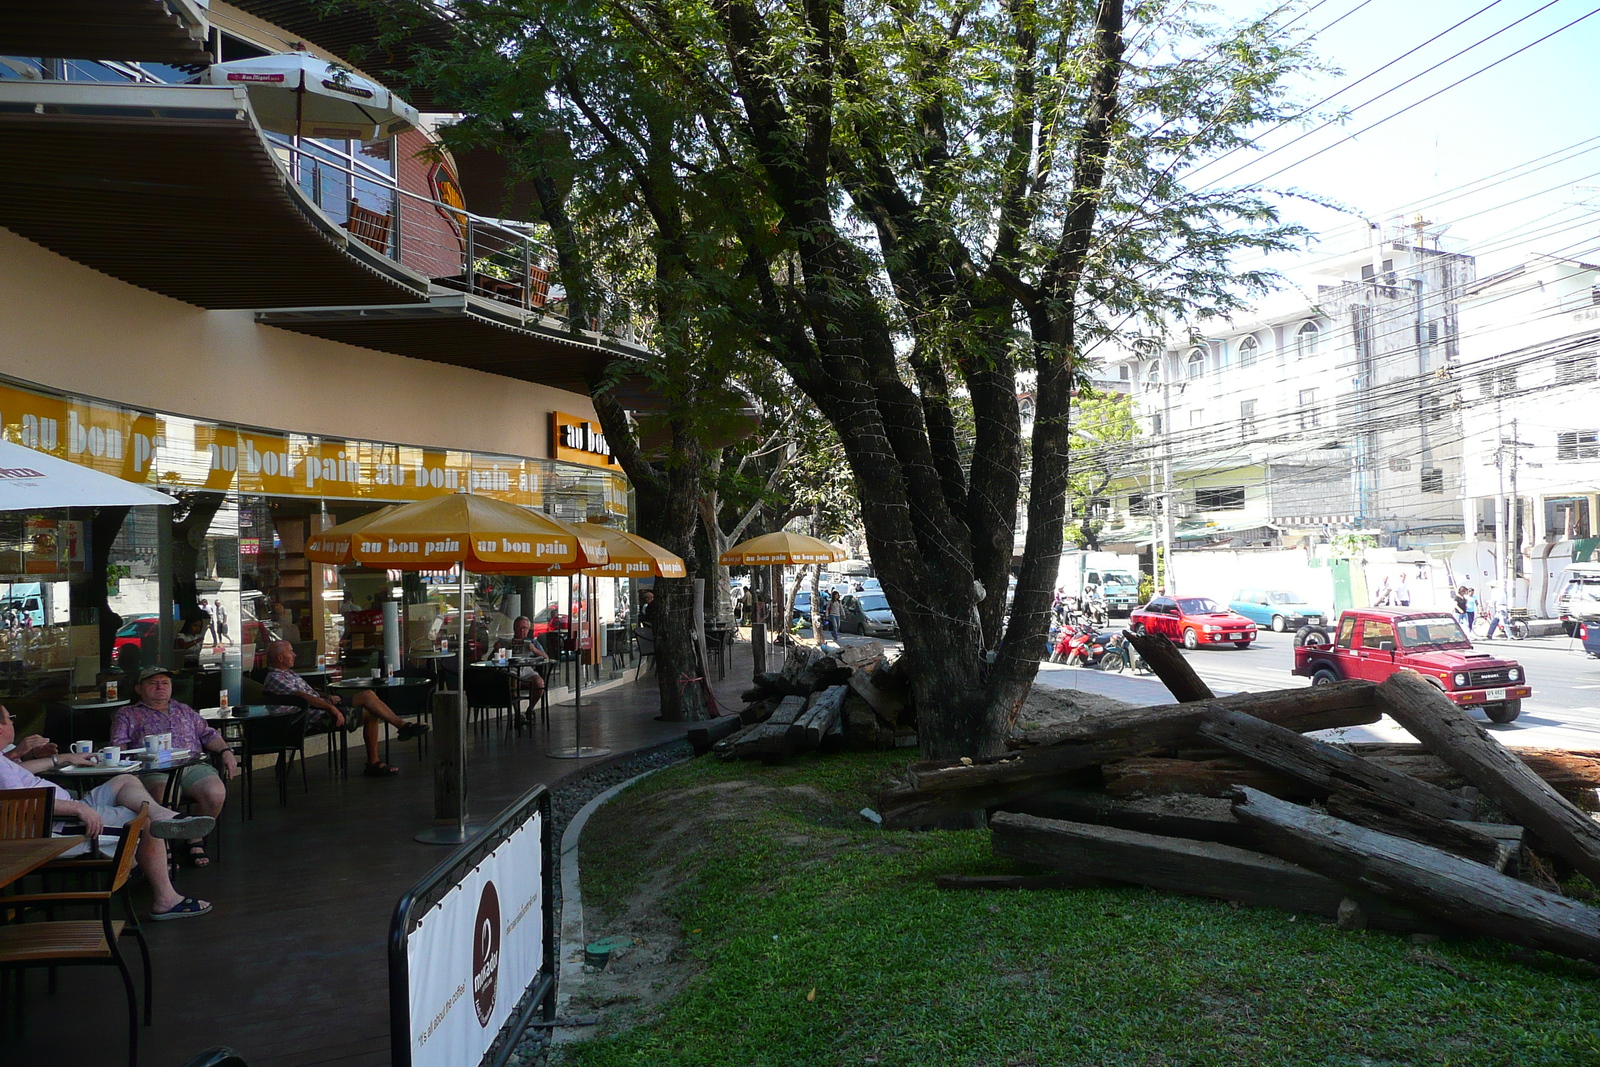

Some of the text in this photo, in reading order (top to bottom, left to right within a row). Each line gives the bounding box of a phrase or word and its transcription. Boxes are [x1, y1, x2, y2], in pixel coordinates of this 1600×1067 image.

[22, 413, 58, 451] au
[69, 411, 123, 459] bon
[560, 423, 583, 450] au
[246, 439, 295, 478] bon
[305, 450, 360, 488] pain
[375, 463, 405, 486] au
[415, 458, 459, 489] bon
[467, 463, 510, 495] pain
[519, 473, 539, 492] au
[360, 537, 460, 556] au bon pain
[477, 537, 568, 557] au bon pain
[756, 554, 769, 562] bon
[771, 554, 787, 563] pain
[815, 553, 830, 562] pain
[625, 561, 650, 574] pain
